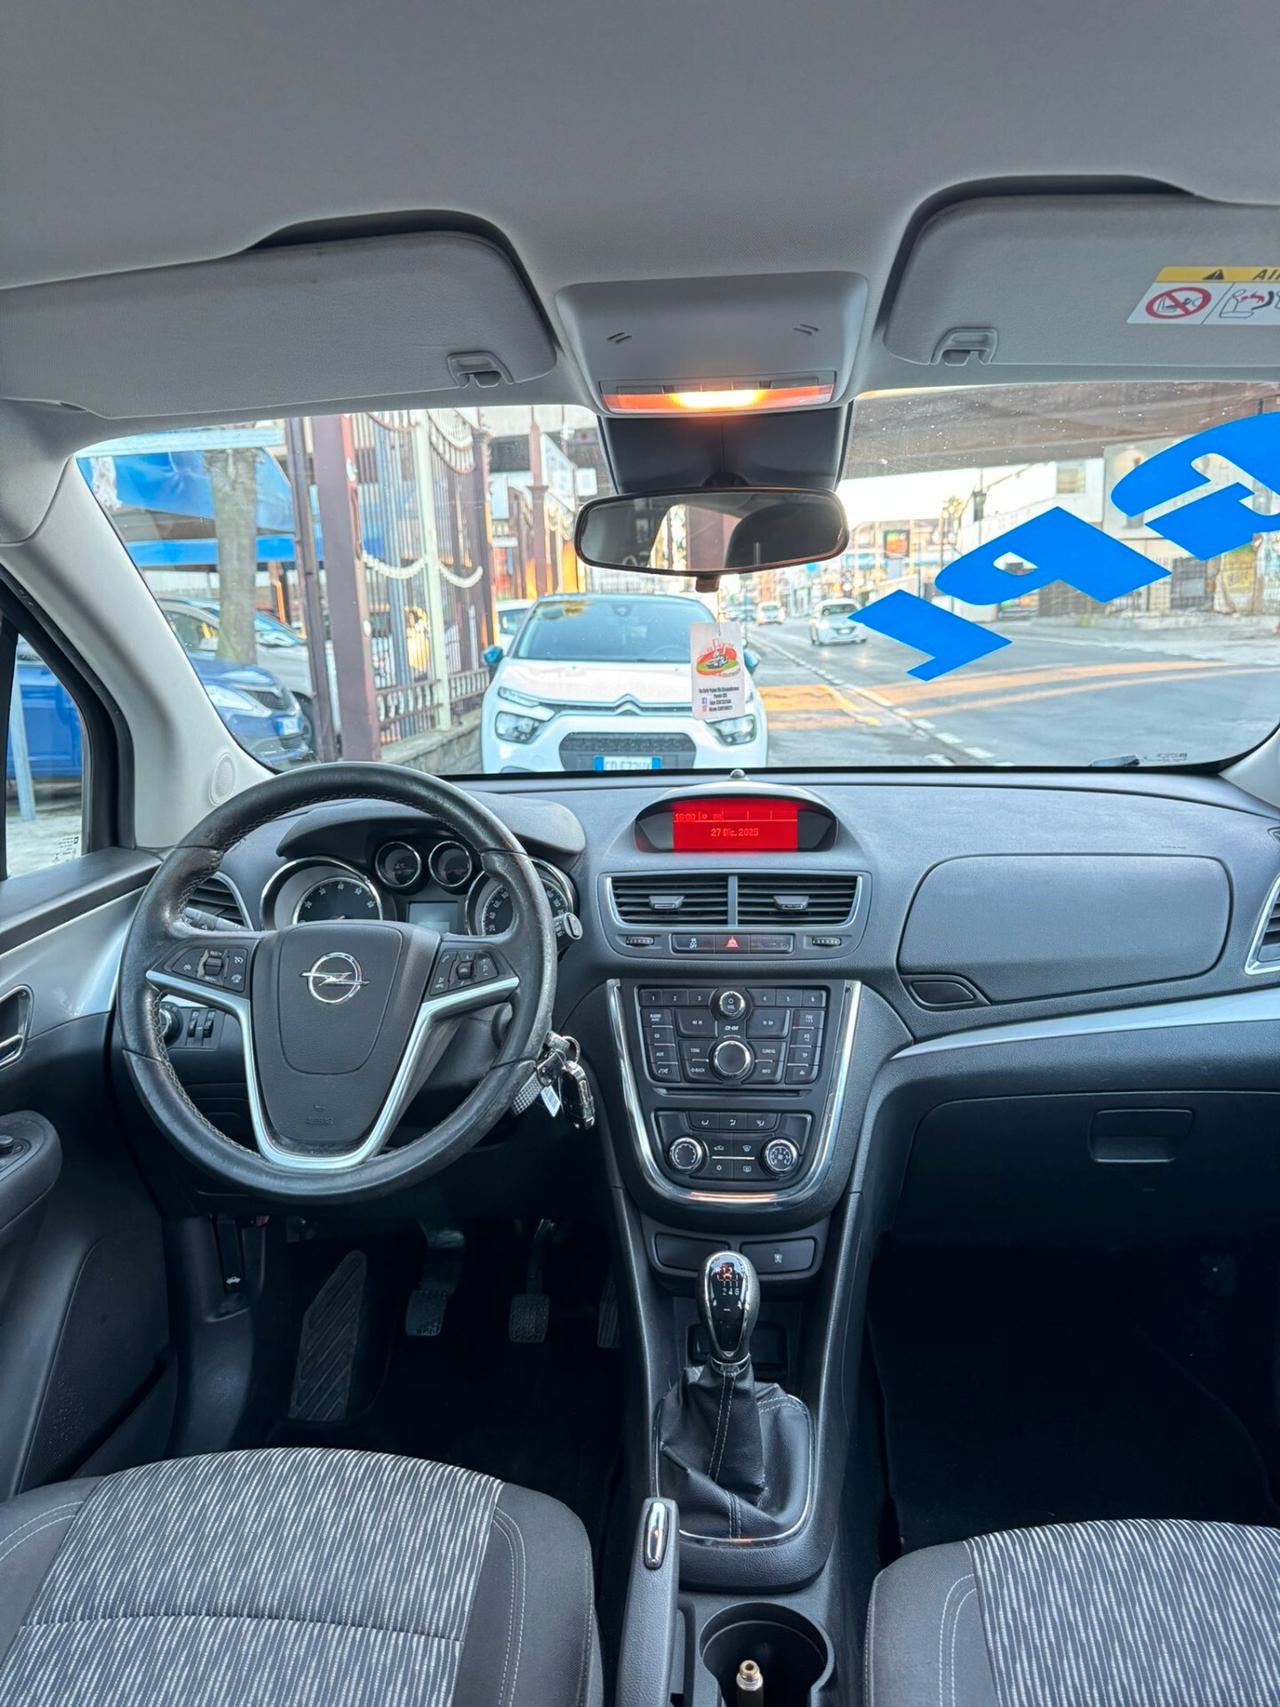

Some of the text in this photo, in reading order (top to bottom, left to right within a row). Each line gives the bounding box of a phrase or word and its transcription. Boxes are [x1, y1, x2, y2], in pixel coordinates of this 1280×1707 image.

[710, 828, 721, 837] 27
[738, 828, 759, 837] 2025
[722, 1287, 727, 1296] 2
[728, 1287, 733, 1296] 4
